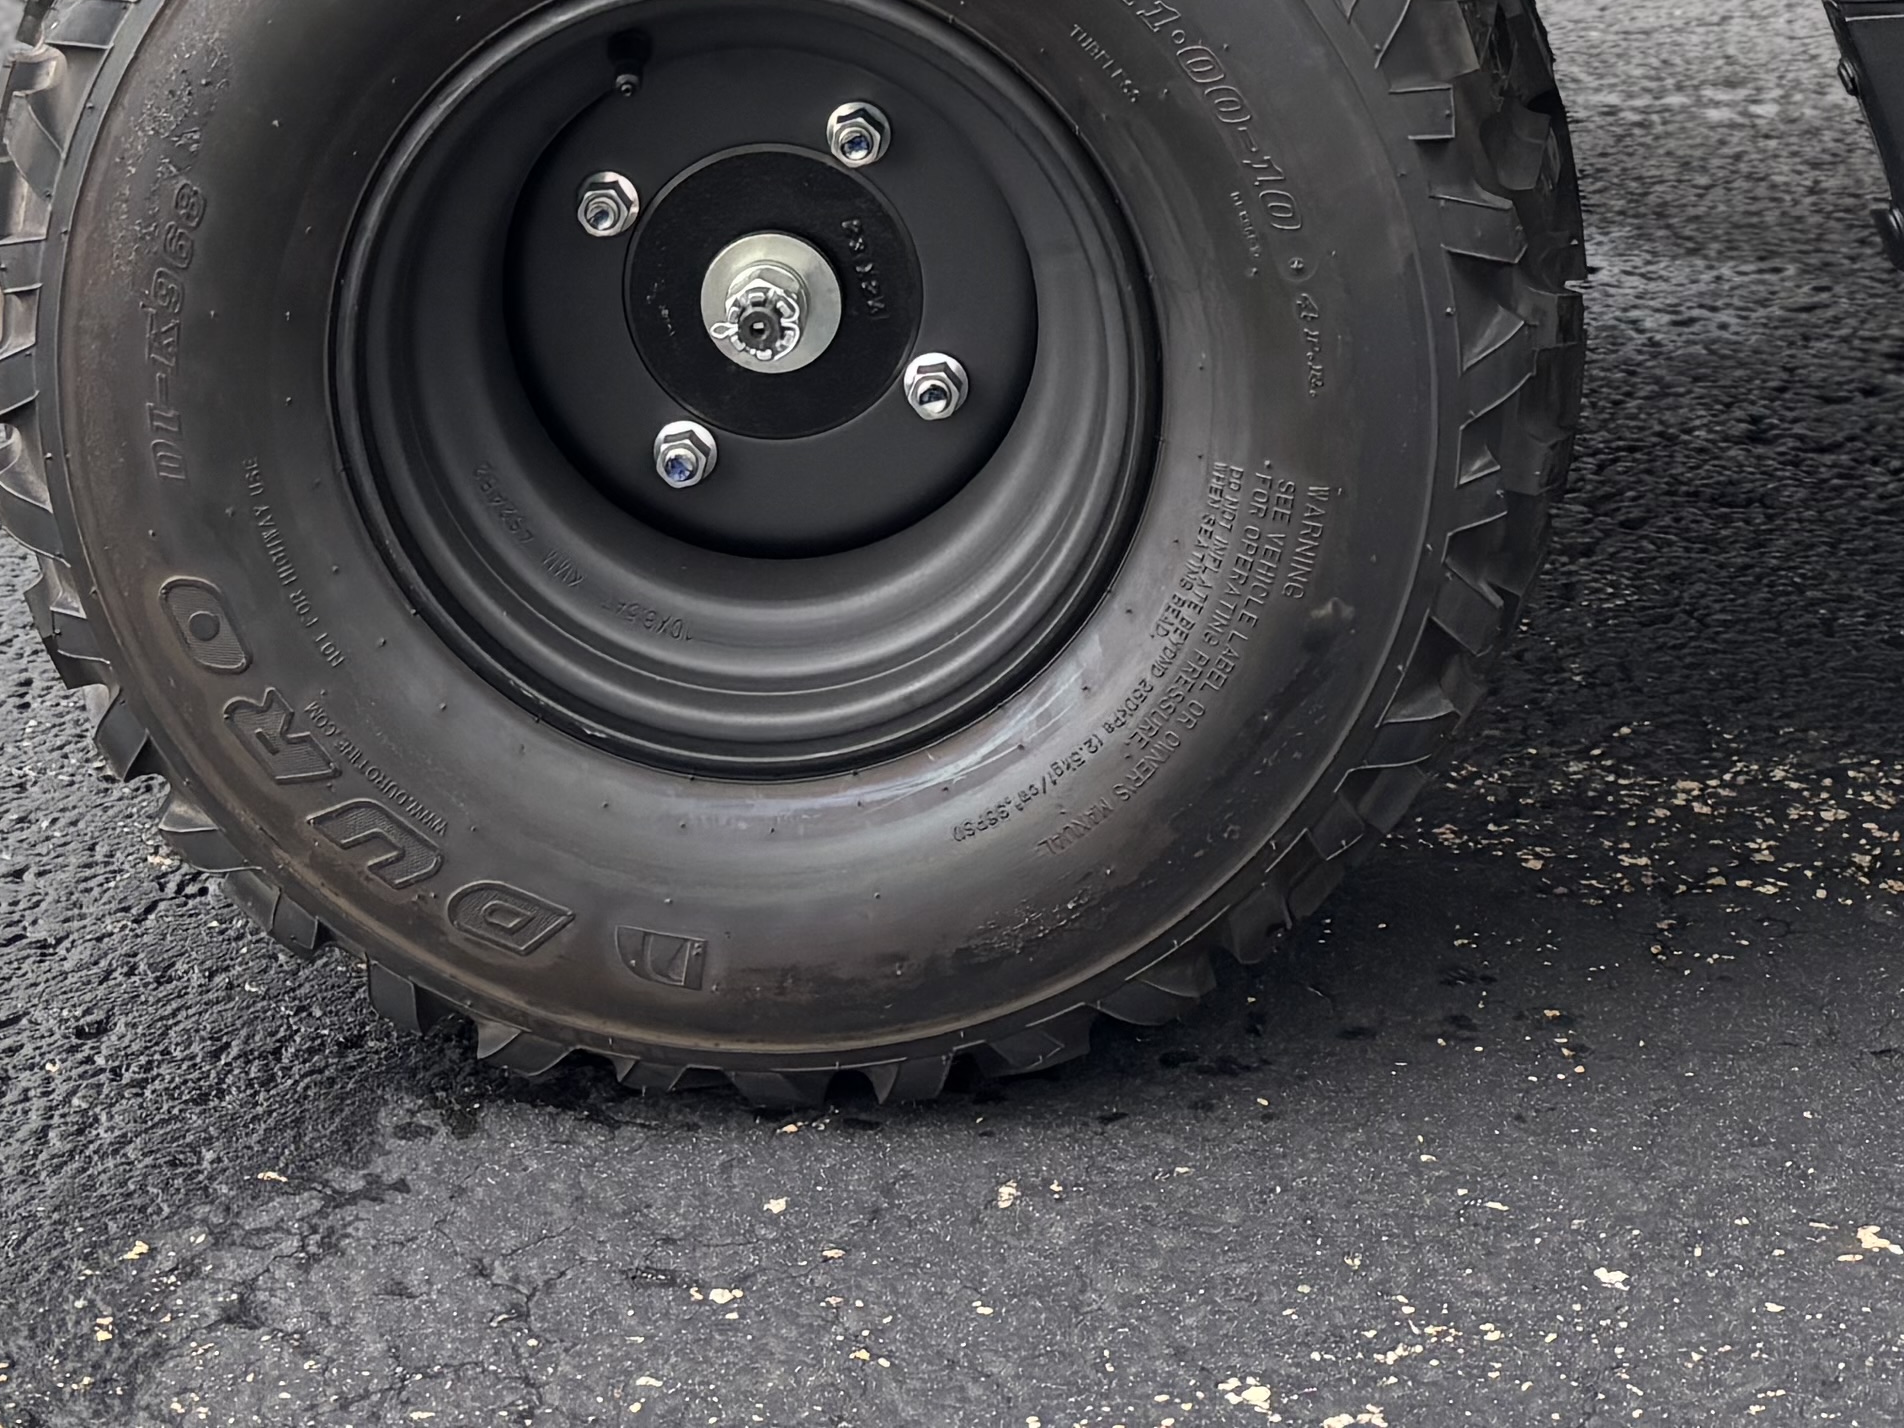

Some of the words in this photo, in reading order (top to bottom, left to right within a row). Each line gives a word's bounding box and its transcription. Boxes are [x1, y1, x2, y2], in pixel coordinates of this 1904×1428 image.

[240, 455, 266, 497] USE
[1248, 472, 1273, 519] FOR
[1271, 478, 1296, 526] SEE
[252, 501, 298, 586] HIGHWAY
[1176, 511, 1218, 592] SEATING
[1186, 535, 1229, 614] INFLATE
[1280, 482, 1331, 602] WARNING
[286, 586, 320, 628] FOR
[1200, 524, 1261, 648] OPERATING
[1236, 529, 1286, 629] VEHICLE
[310, 628, 347, 669] NOT
[1148, 615, 1195, 679] BEYOND
[1198, 629, 1249, 699] LABEL
[1177, 698, 1206, 731] OR
[157, 574, 576, 958] DURO
[1036, 796, 1114, 861] MANUAL
